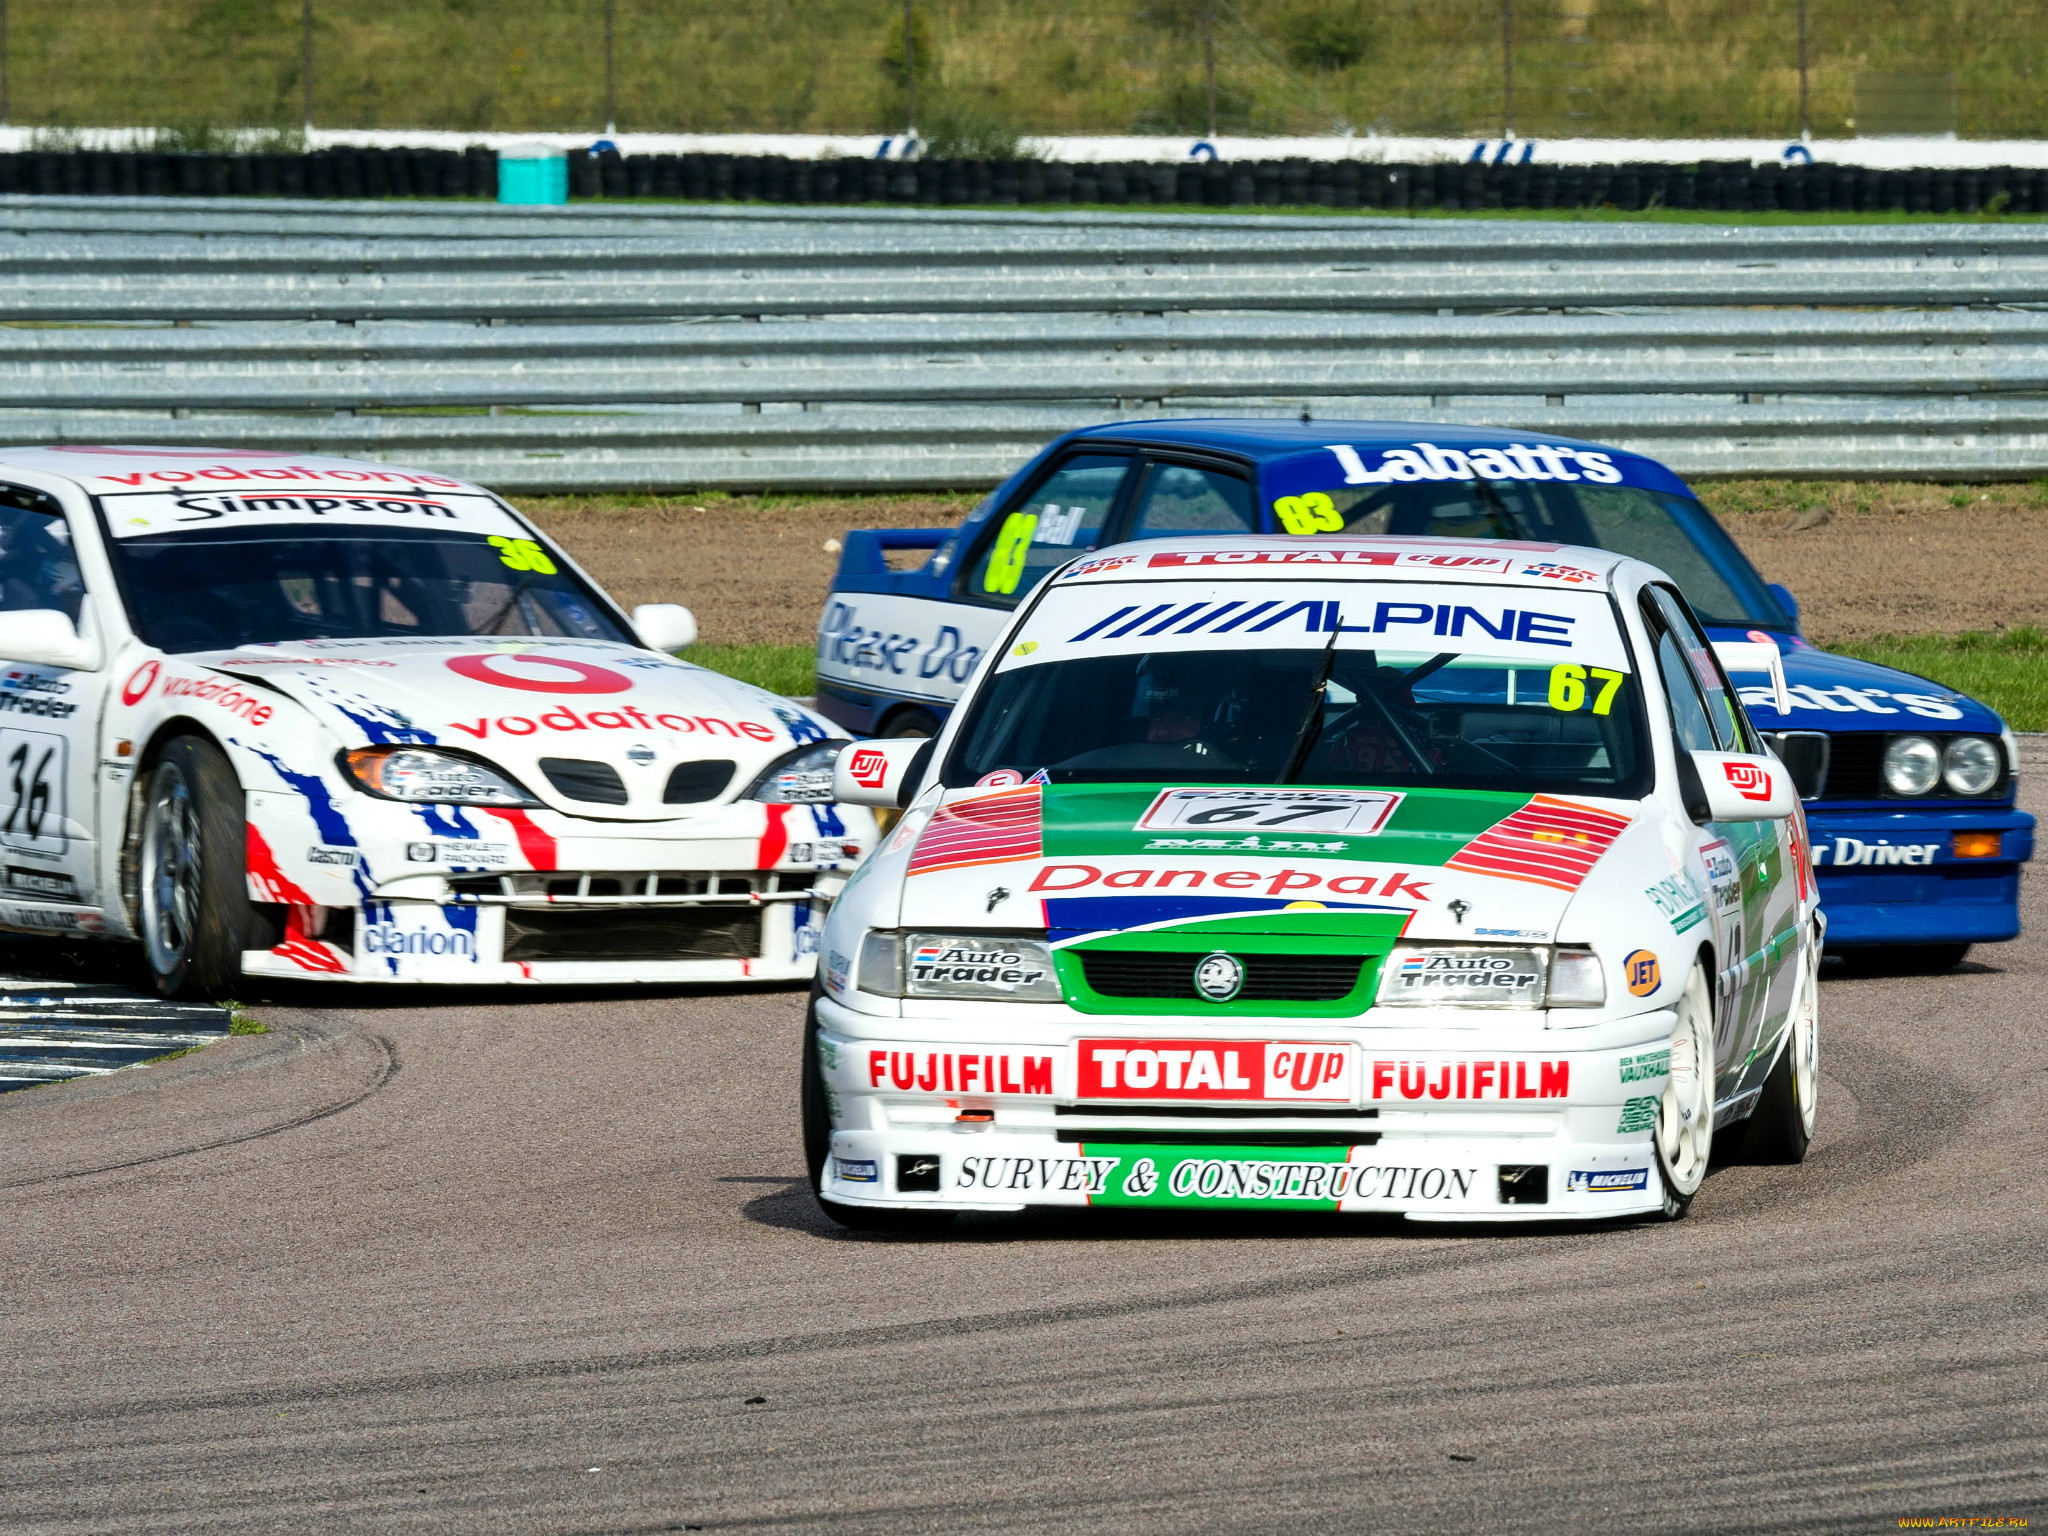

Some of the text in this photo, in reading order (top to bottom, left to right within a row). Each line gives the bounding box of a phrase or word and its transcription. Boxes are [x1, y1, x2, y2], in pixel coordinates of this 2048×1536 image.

[97, 466, 460, 488] vodafone
[1323, 443, 1623, 485] Labatt's
[176, 495, 457, 521] Simpson
[1274, 492, 1345, 536] 83
[487, 536, 558, 575] 36
[1175, 551, 1372, 564] TOTAL
[1525, 564, 1599, 582] TOTAL
[819, 601, 918, 674] Please
[1246, 600, 1576, 648] ALPINE
[162, 674, 274, 726] vodafone
[1548, 664, 1624, 715] 67
[1737, 685, 1964, 720] att's
[448, 705, 777, 742] vodafone
[849, 752, 888, 783] FUJI
[1723, 764, 1772, 797] FUJI
[7, 742, 54, 840] 36
[1186, 803, 1351, 826] 67
[1143, 836, 1350, 854] Mint
[1834, 838, 1941, 866] Driver
[1027, 864, 1435, 902] Danepak
[364, 925, 468, 955] clarion
[939, 949, 1021, 965] Auto
[1425, 956, 1512, 970] Auto
[1630, 959, 1656, 987] JET
[914, 965, 1042, 984] Trader
[1401, 972, 1535, 988] Trader
[870, 1050, 1054, 1095] FUJIFILM
[1092, 1049, 1251, 1091] TOTAL
[1372, 1060, 1569, 1100] FUJIFILM
[1620, 1060, 1671, 1083] VAUXHALL
[957, 1156, 1477, 1200] SURVEY & CONSTRUCTION
[1589, 1171, 1646, 1188] MICHELIN
